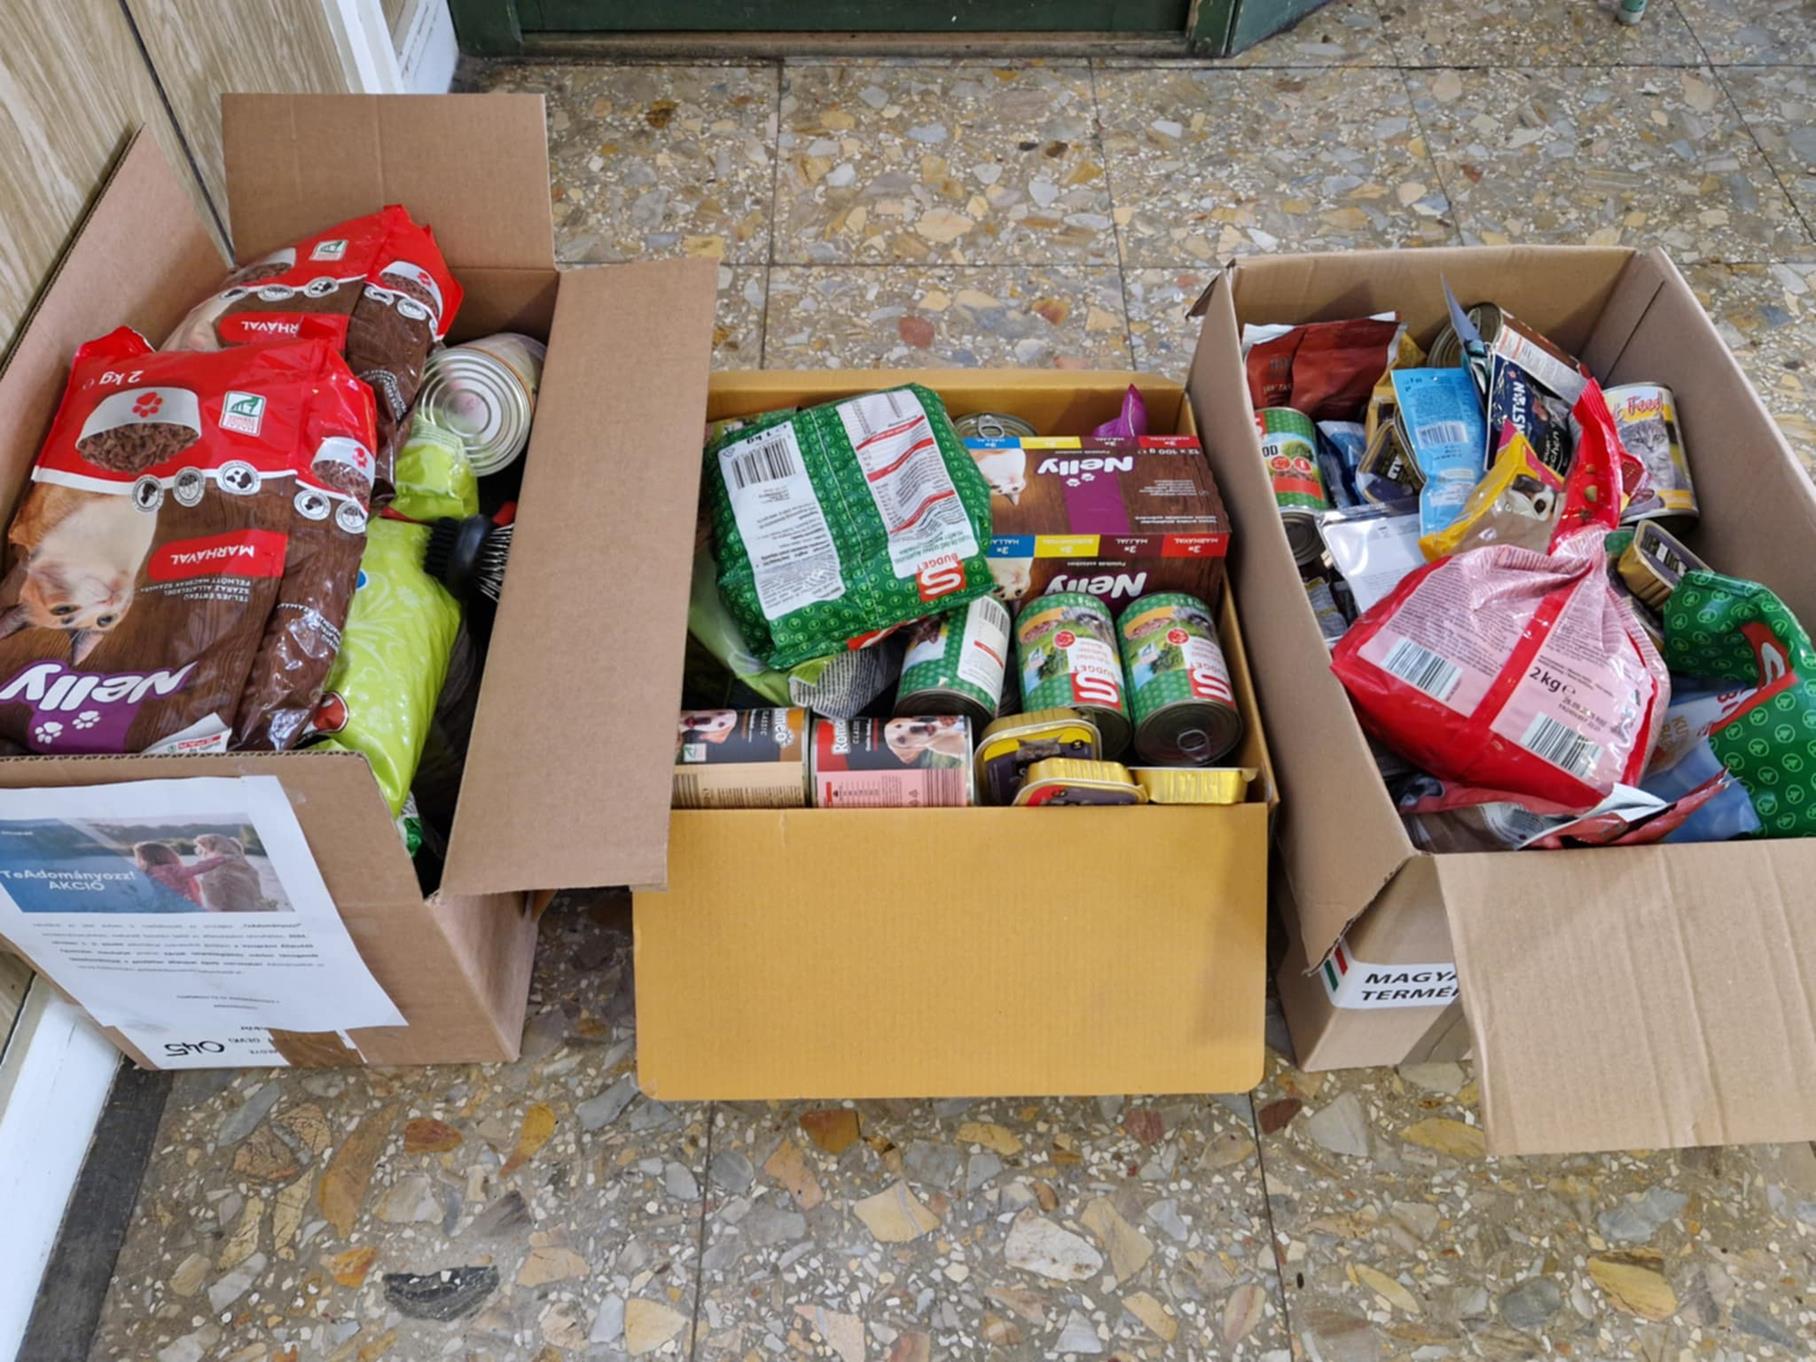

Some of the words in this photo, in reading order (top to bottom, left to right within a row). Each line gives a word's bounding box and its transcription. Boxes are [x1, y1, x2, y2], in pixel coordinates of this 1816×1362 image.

[241, 321, 299, 336] RHÁVAL
[99, 371, 125, 385] kg
[128, 370, 144, 383] 2
[1512, 382, 1526, 434] NSTON
[1037, 456, 1134, 475] Nelly
[170, 545, 255, 566] MARHÁVAL
[0, 661, 198, 711] Nelly
[49, 880, 105, 891] AKCIÓ
